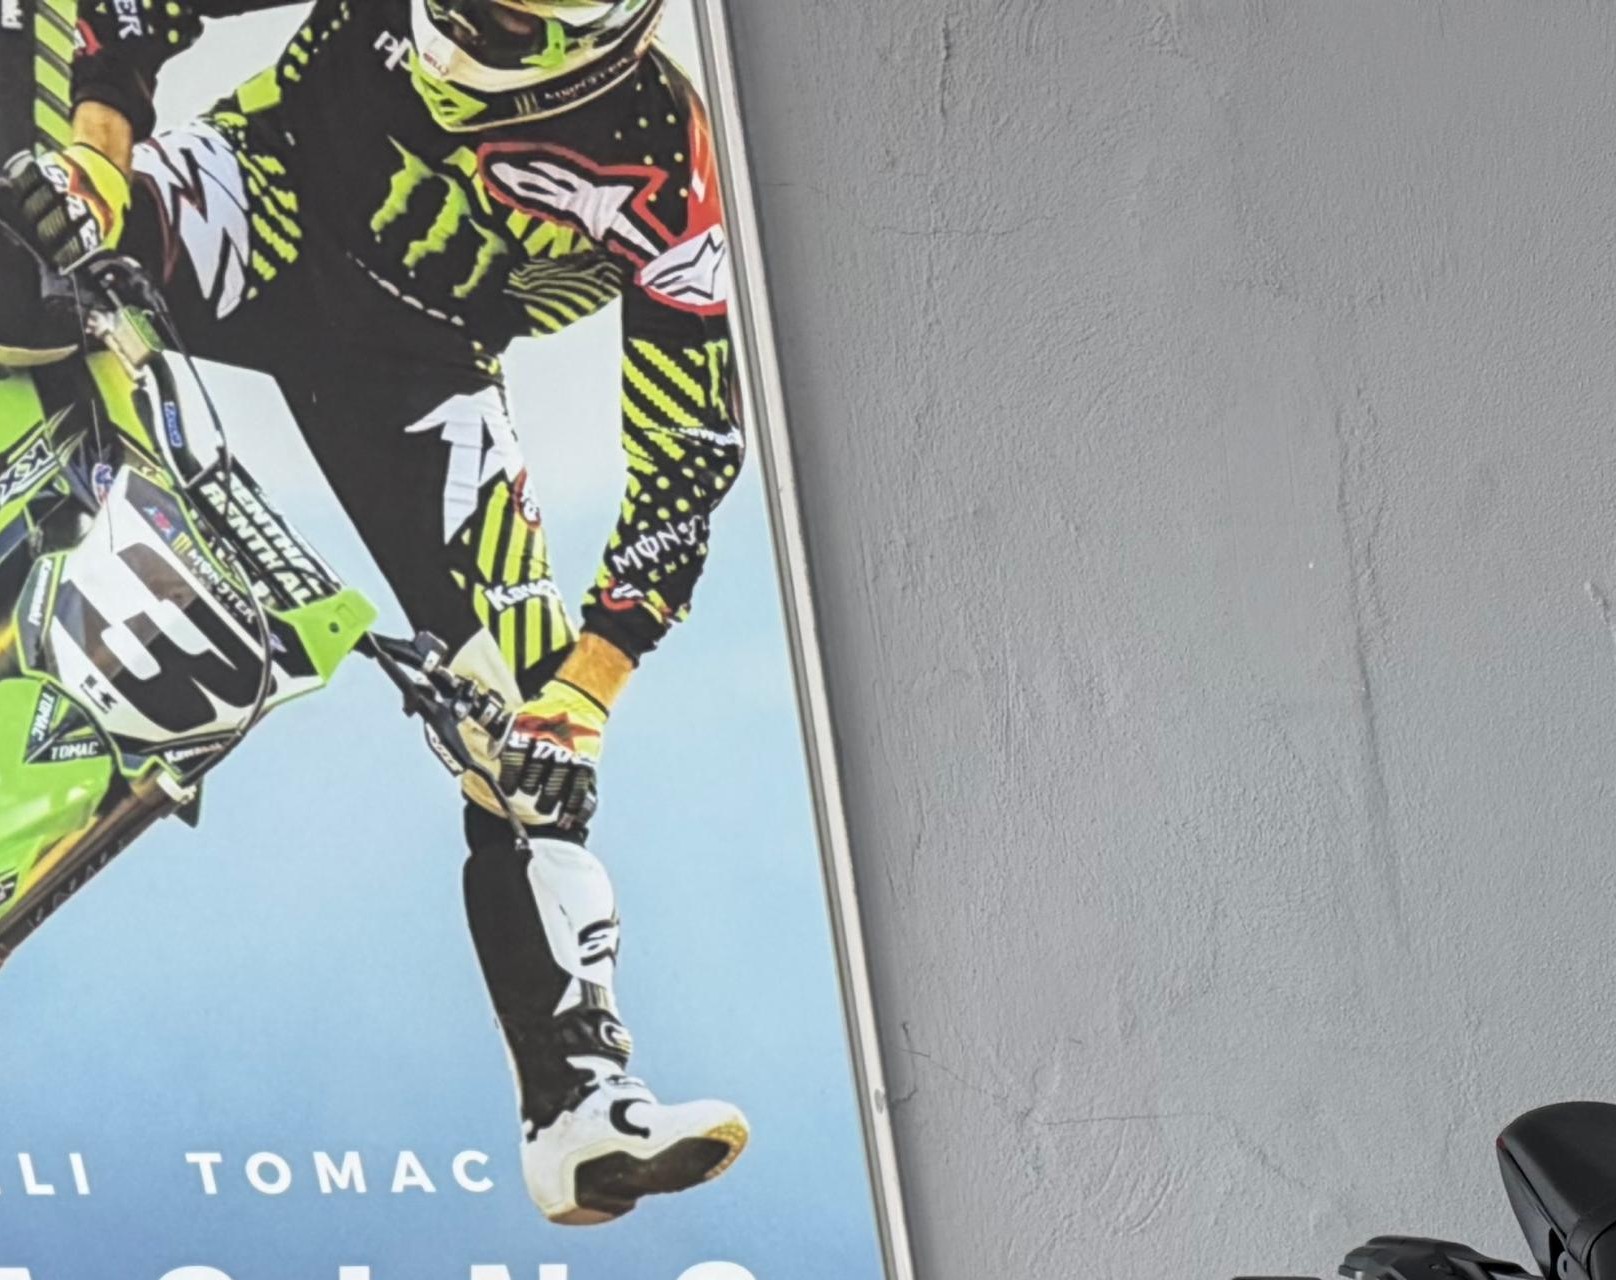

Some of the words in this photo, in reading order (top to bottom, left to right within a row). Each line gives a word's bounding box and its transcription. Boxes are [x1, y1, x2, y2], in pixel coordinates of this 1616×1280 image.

[31, 692, 55, 742] TOMAC
[51, 741, 98, 761] TOMAC
[0, 1152, 89, 1195] LI
[185, 1150, 494, 1195] TOMAC
